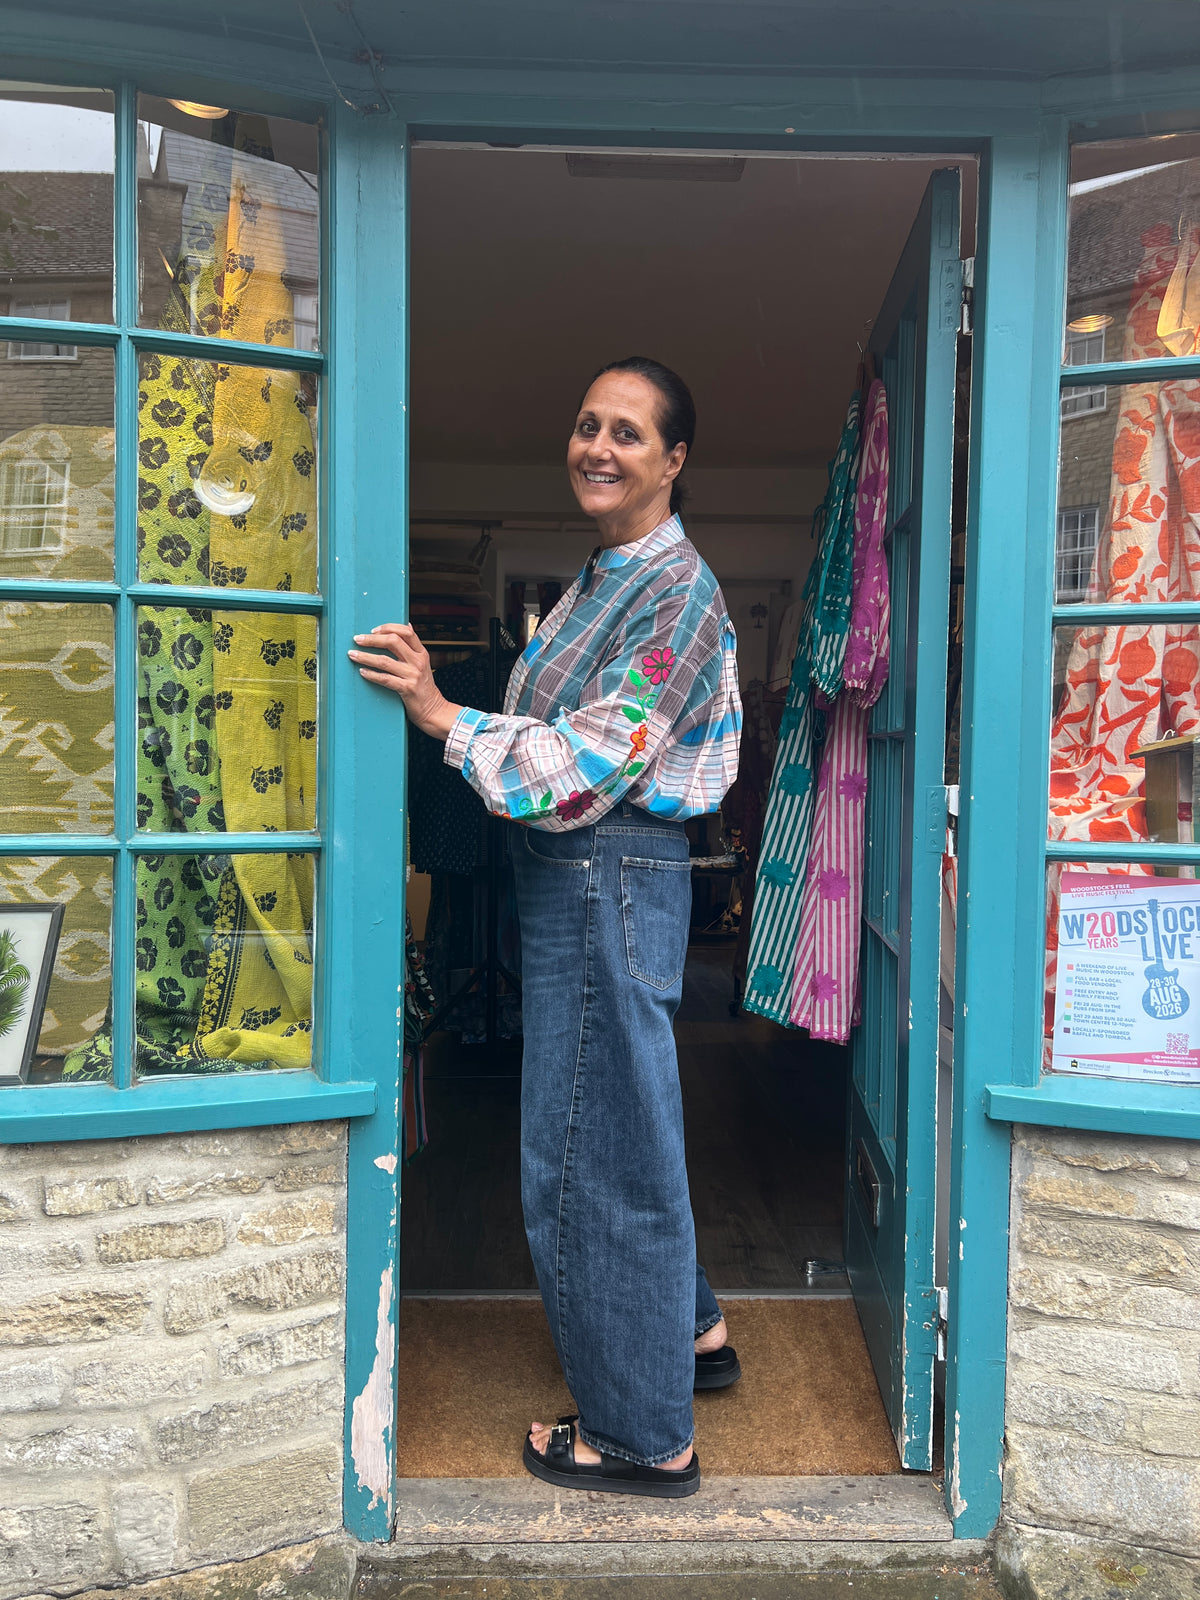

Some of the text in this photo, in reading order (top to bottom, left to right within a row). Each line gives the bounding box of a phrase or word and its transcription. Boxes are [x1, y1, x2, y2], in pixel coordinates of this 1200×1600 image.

[1070, 884, 1115, 892] WOODSTOCK'S
[1087, 937, 1119, 950] YEARS
[1150, 976, 1175, 988] 28-30
[1150, 984, 1182, 1006] AUG
[1154, 1002, 1182, 1018] 2026
